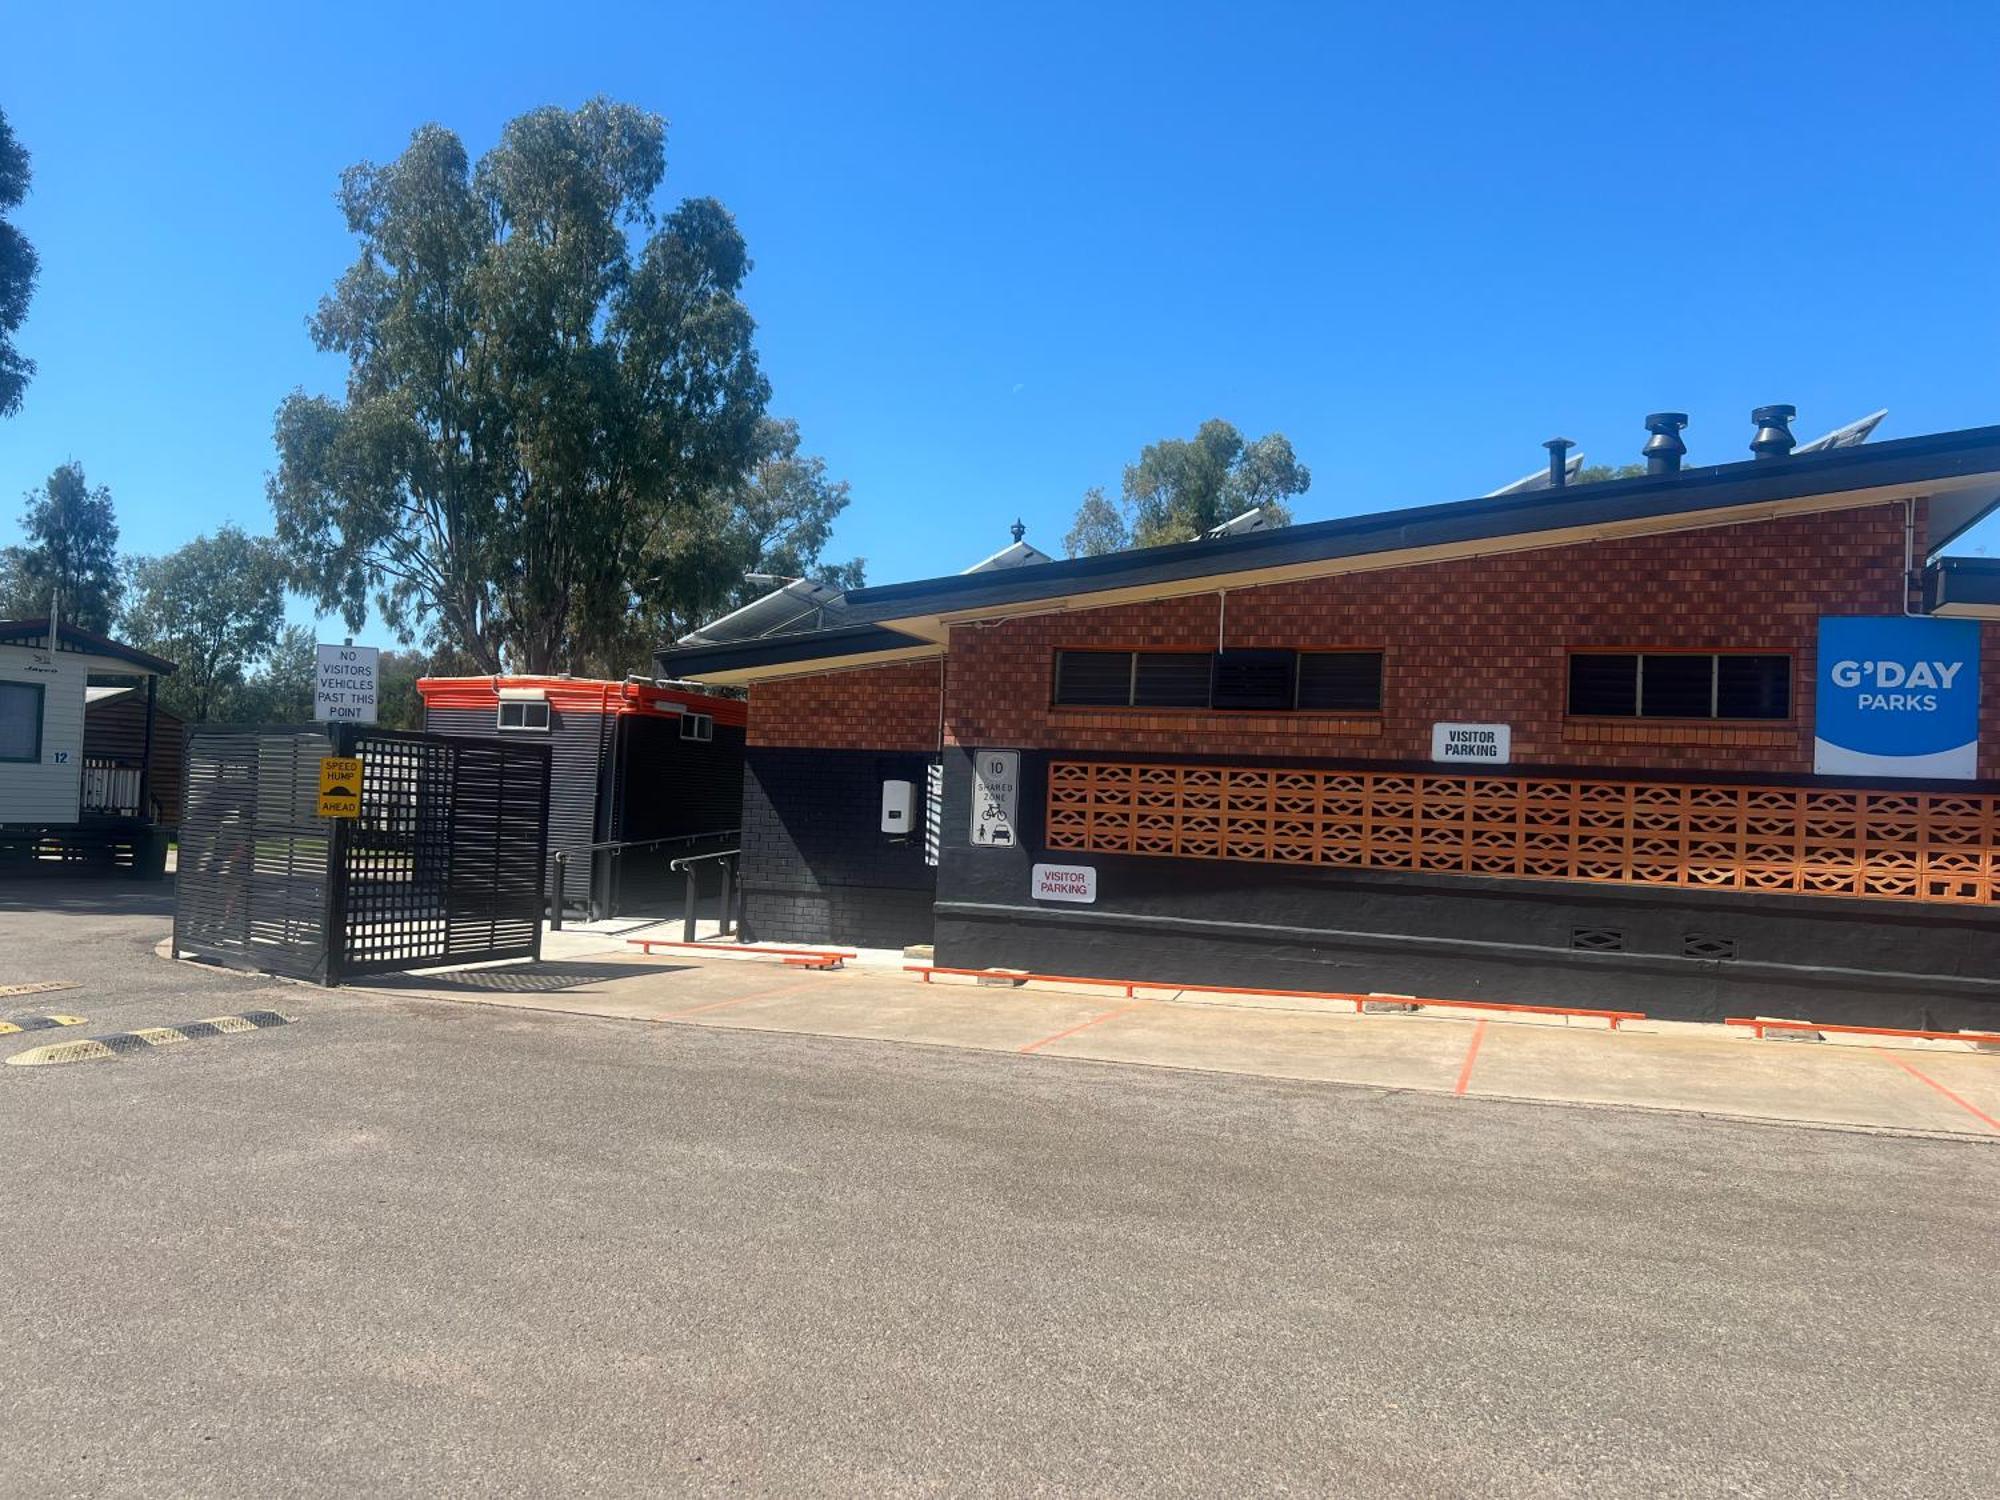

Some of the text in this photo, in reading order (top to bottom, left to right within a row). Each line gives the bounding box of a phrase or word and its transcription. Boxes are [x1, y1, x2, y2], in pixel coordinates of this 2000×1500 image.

[340, 651, 357, 661] NO
[323, 663, 372, 676] VISITORS
[1831, 660, 1964, 689] G'DAY
[320, 678, 374, 690] VEHICLES
[318, 693, 374, 705] PAST THIS
[1858, 694, 1937, 711] PARKS
[329, 707, 362, 718] POINT
[1449, 730, 1495, 743] VISITOR
[1445, 743, 1497, 757] PARKING
[54, 752, 68, 763] 12
[326, 762, 357, 772] SPEED
[991, 762, 1003, 774] 10
[327, 772, 355, 781] HUMP
[977, 783, 1013, 792] SHARED
[984, 793, 1006, 802] ZONE
[323, 802, 356, 812] AHEAD
[1044, 871, 1085, 884] VISITOR
[1041, 882, 1087, 895] PARKING
